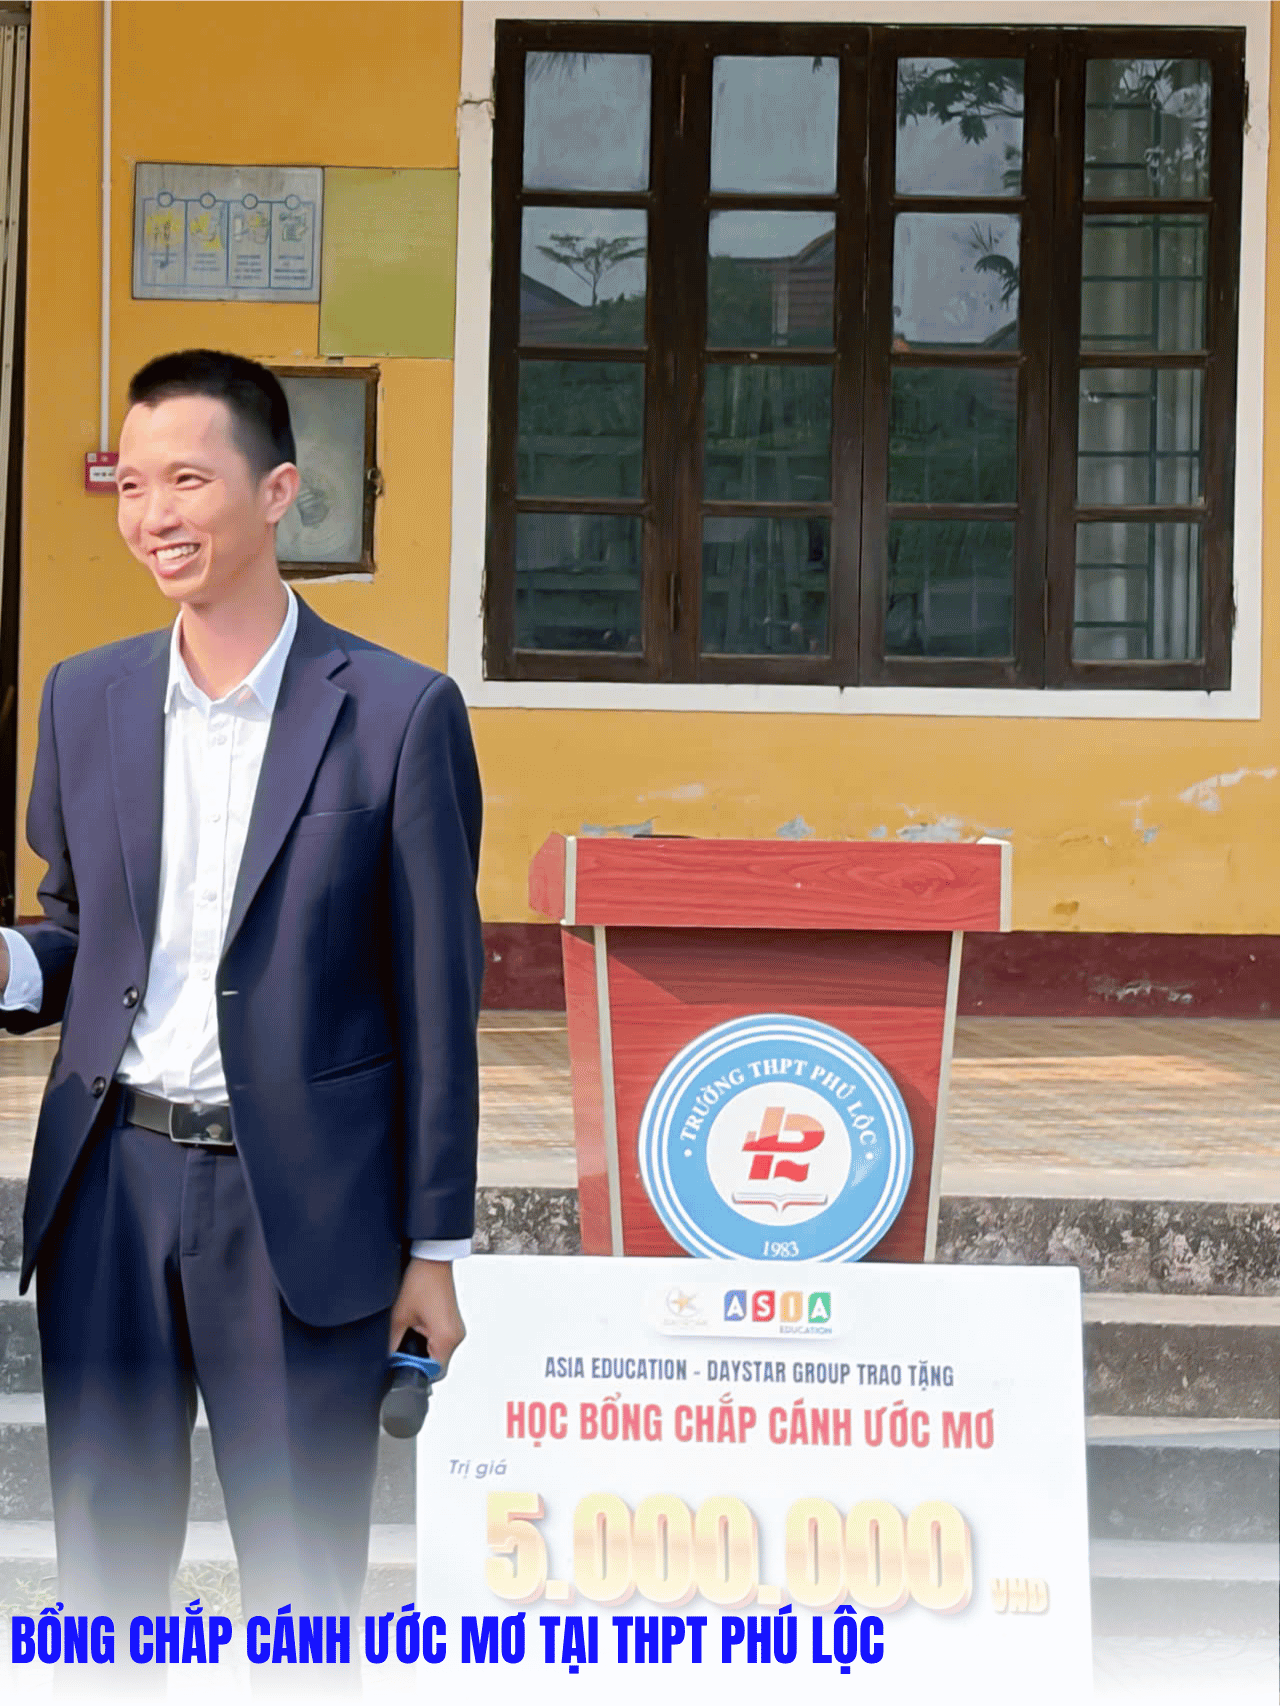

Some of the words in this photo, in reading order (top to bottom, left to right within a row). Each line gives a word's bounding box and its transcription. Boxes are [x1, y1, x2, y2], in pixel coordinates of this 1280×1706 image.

[680, 1068, 745, 1141] TRƯỜNG
[747, 1058, 808, 1078] THPT
[810, 1065, 856, 1099] PHÚ
[846, 1100, 877, 1146] LỘC
[763, 1240, 799, 1257] 1983
[726, 1293, 829, 1320] ASIA
[545, 1356, 585, 1378] ASIA
[591, 1357, 687, 1380] EDUCATION
[707, 1360, 786, 1383] DAYSTAR
[793, 1362, 851, 1385] GROUP
[858, 1363, 902, 1386] TRAO
[909, 1360, 954, 1391] TẶNG
[506, 1401, 568, 1448] HỌC
[580, 1392, 662, 1442] BỔNG
[674, 1392, 757, 1444] CHẮP
[769, 1398, 852, 1446] CÁNH
[864, 1400, 930, 1448] ƯỚC
[942, 1407, 994, 1450] MƠ
[450, 1459, 471, 1479] Trị
[475, 1458, 507, 1479] giá
[485, 1491, 975, 1611] 5.000.000
